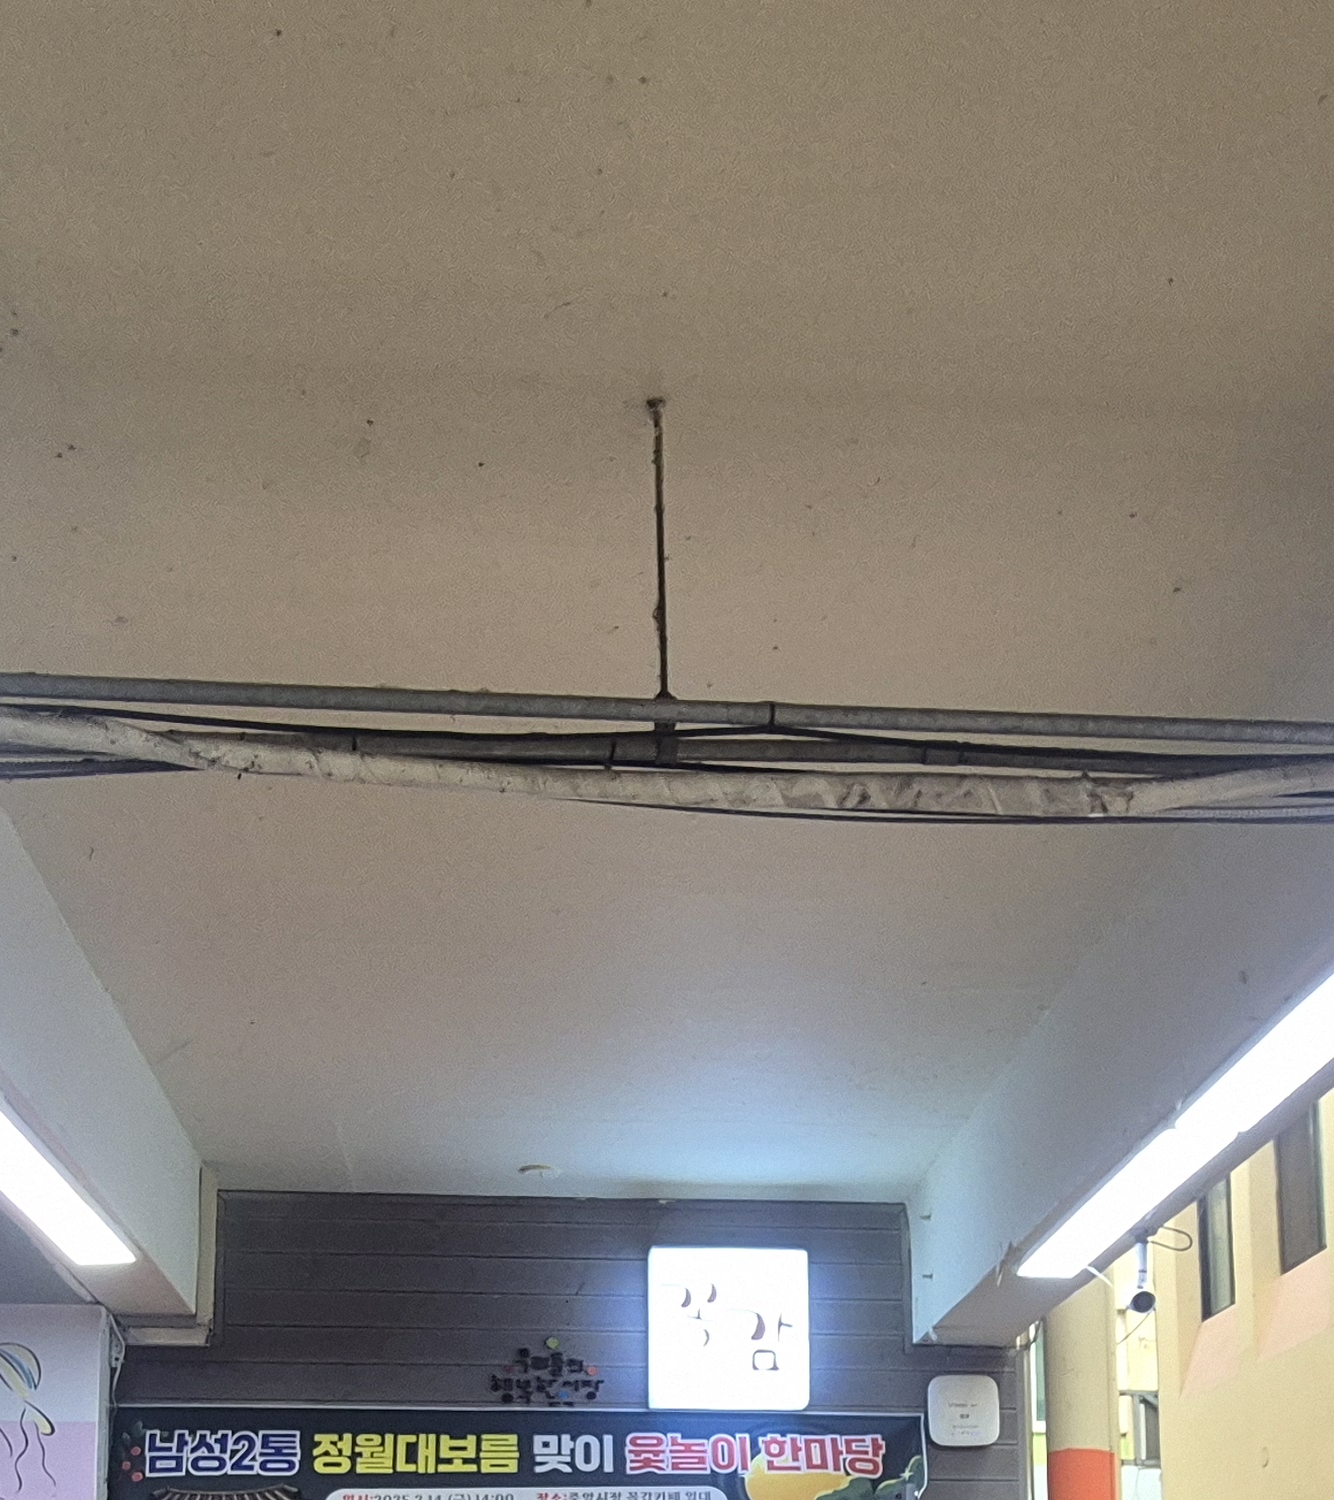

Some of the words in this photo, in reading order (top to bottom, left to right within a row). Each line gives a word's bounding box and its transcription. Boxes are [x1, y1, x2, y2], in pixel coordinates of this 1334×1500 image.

[145, 1429, 301, 1476] 남성2통
[312, 1433, 519, 1474] 정월대보름
[533, 1433, 614, 1474] 맞이
[624, 1431, 750, 1475] 윷놀이
[759, 1434, 885, 1478] 한마당
